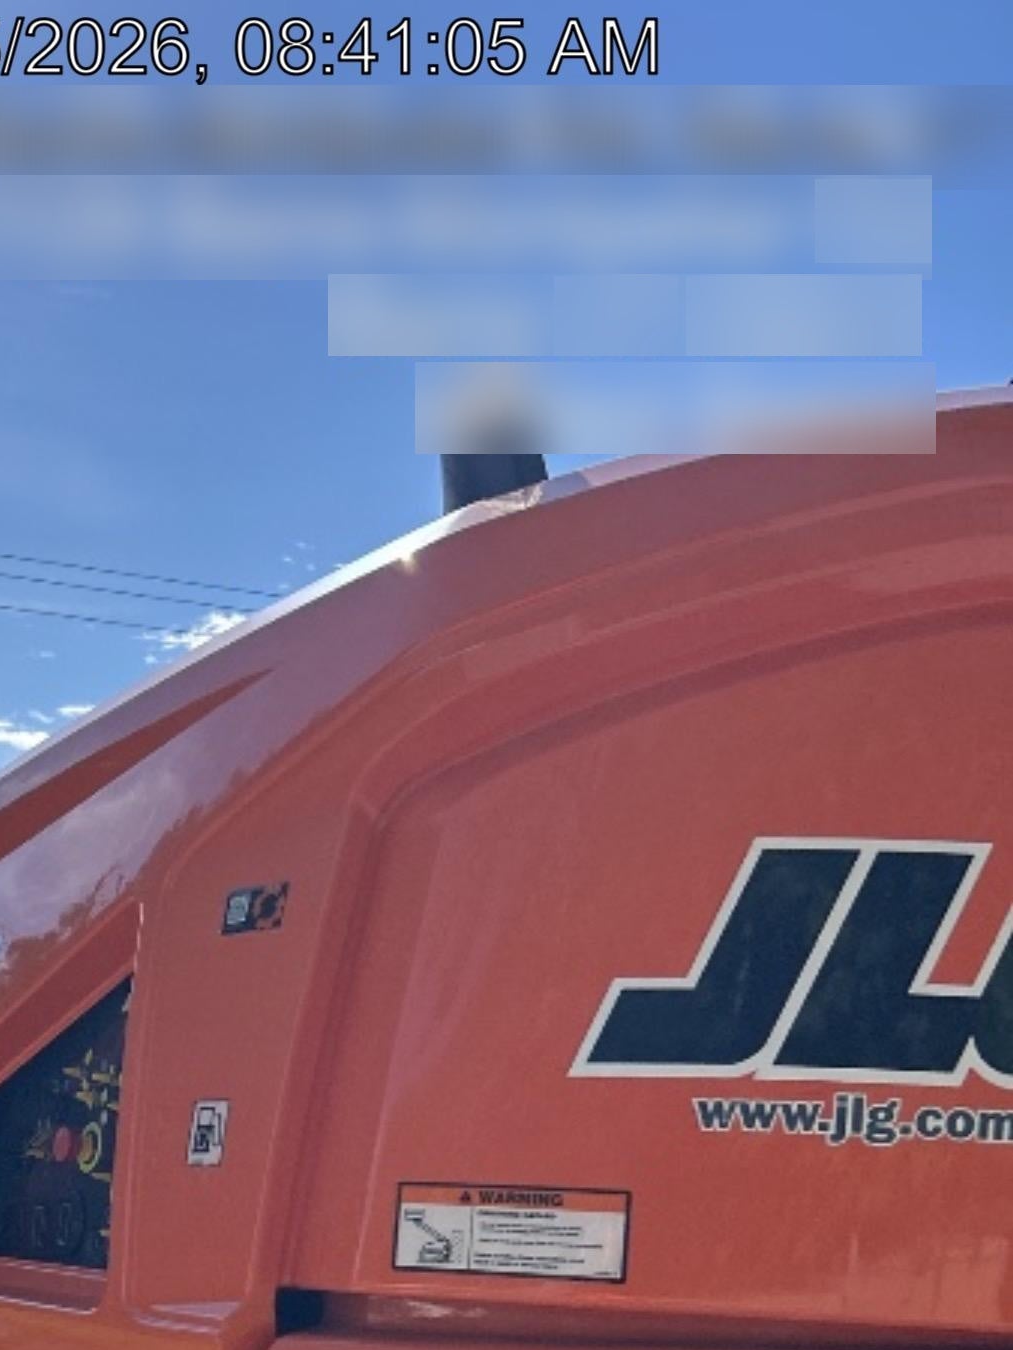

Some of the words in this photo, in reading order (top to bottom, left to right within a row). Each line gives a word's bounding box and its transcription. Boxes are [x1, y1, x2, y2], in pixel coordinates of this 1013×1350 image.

[567, 836, 1013, 1088] JL
[693, 1093, 1013, 1146] www.jlg.com
[478, 1190, 565, 1207] WARNING
